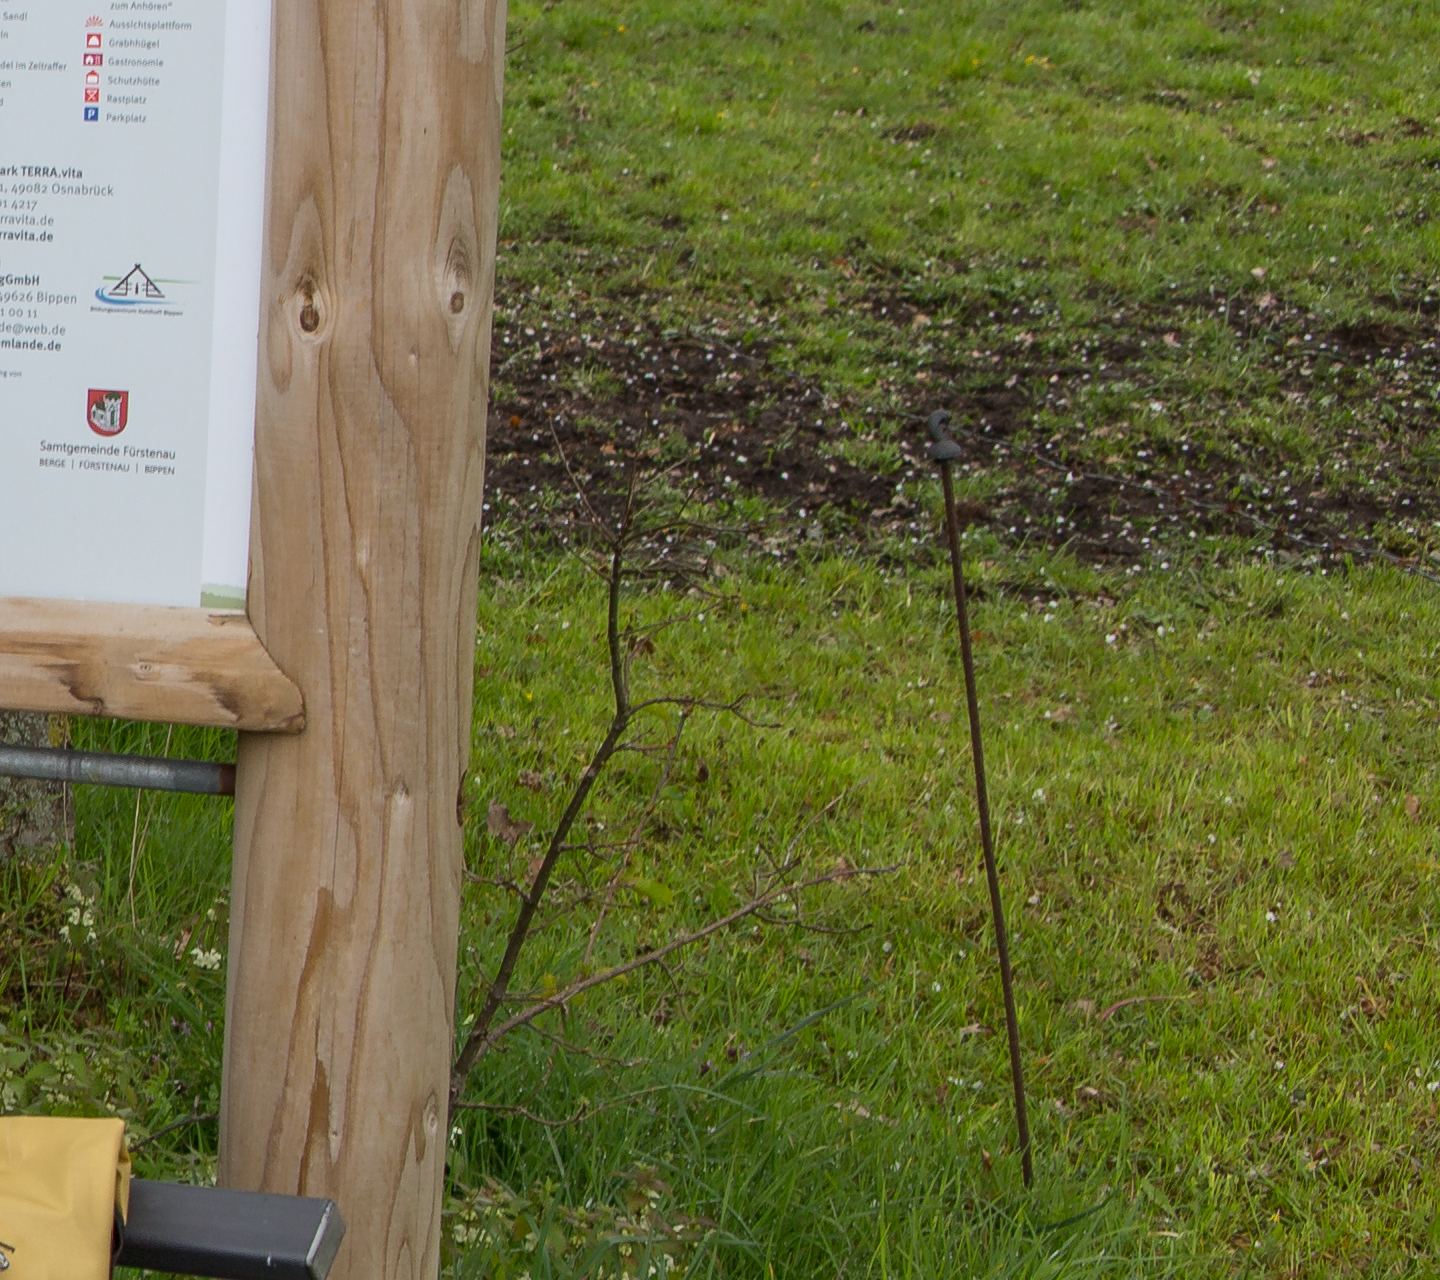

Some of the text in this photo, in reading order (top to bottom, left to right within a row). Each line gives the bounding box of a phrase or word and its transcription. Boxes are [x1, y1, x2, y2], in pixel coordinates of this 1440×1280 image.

[21, 165, 83, 179] TERRA.vita
[40, 439, 176, 460] Samtgemeinde Fürstenau
